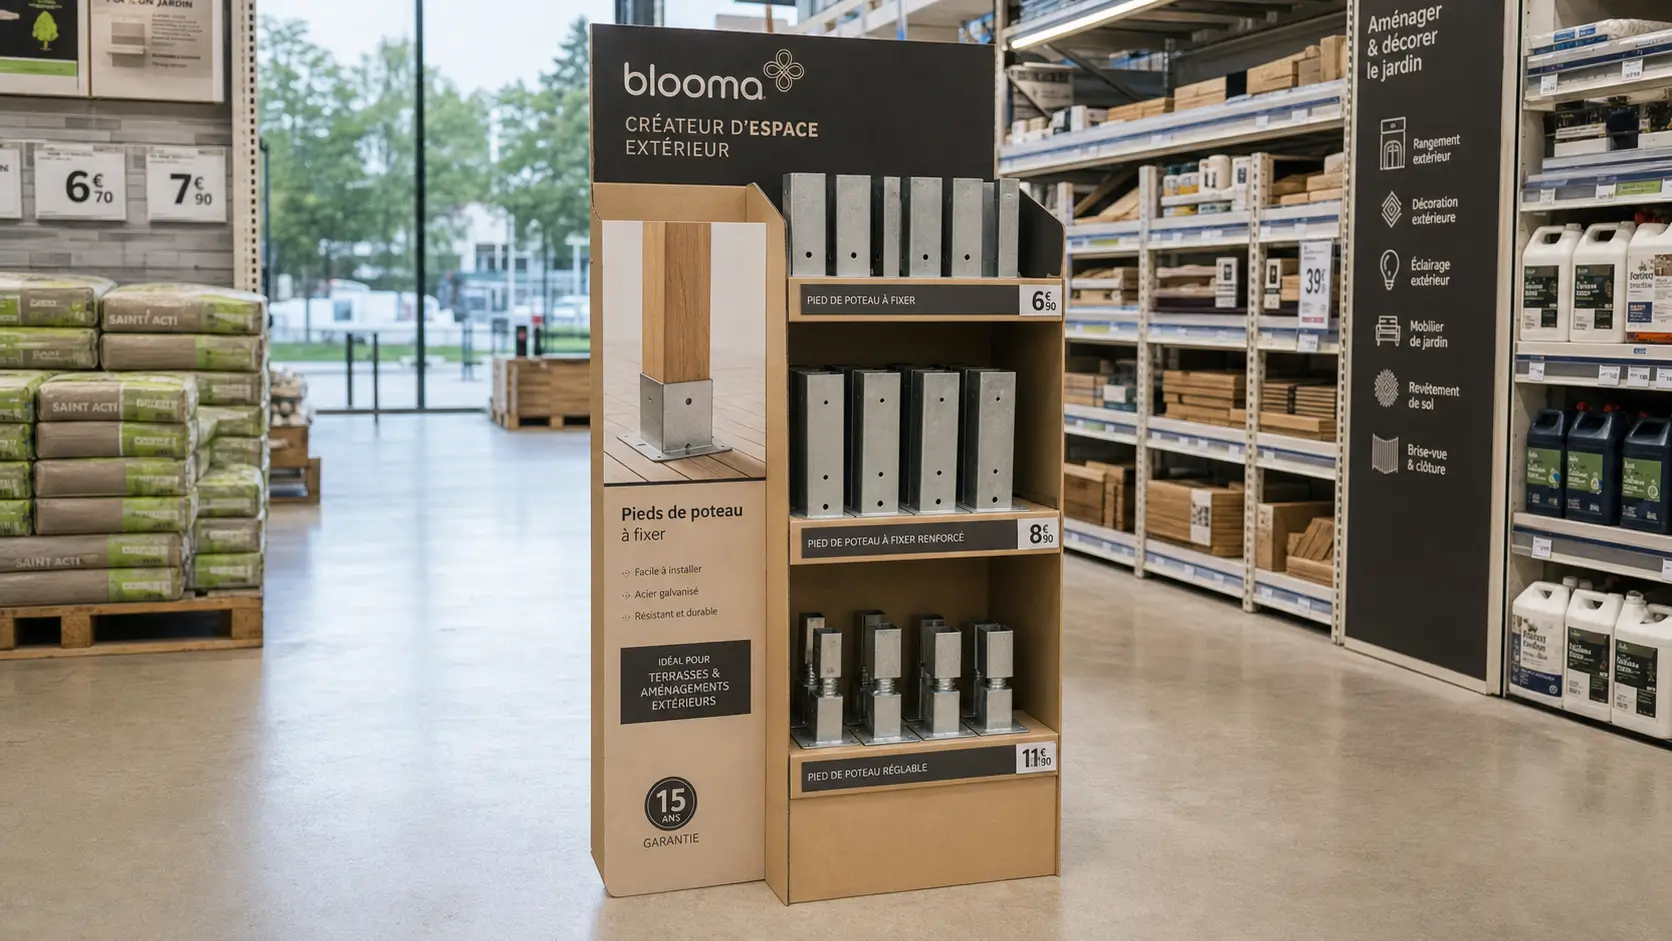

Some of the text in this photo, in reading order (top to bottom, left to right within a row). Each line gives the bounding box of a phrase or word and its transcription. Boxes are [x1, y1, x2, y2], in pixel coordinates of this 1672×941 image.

[1368, 4, 1442, 34] Aménager
[1368, 30, 1438, 56] & décorer
[1367, 54, 1422, 82] le jardin
[624, 62, 765, 100] blooma
[625, 113, 724, 134] CRÉATEUR
[626, 138, 730, 158] EXTÉRIEUR
[1413, 134, 1460, 151] Rangement
[1413, 150, 1451, 165] extérieur
[1412, 197, 1458, 210] Décoration
[1412, 211, 1456, 225] extérieure
[1411, 256, 1450, 273] Éclairage
[1411, 274, 1450, 286] extérieur
[807, 293, 916, 305] PIED DE POTEAU À FIXER
[1410, 320, 1444, 332] Mobilier
[1410, 335, 1448, 350] de jardin
[52, 402, 89, 412] SAINT
[1408, 398, 1434, 410] de sol
[1408, 444, 1447, 460] Brise-vue
[1407, 459, 1414, 471] &
[621, 505, 743, 522] Pieds de poteau
[621, 528, 665, 542] à fixer
[807, 531, 965, 548] PIED DE POTEAU À FIXER RENFORCÉ
[16, 557, 51, 568] SAINT
[634, 565, 702, 576] Facile à installer
[634, 587, 698, 599] Acier galvanisé
[635, 607, 718, 620] Résistant et durable
[658, 655, 710, 666] IDÉAL POUR
[649, 668, 720, 682] TERRASSES &
[641, 681, 730, 697] AMÉNAGEMENTS
[652, 696, 716, 710] EXTÉRIEURS
[807, 763, 928, 782] PIED DE POTEAU RÉGLABLE
[656, 788, 686, 813] 15
[662, 814, 680, 823] ANS
[644, 833, 699, 848] GARANTIE
